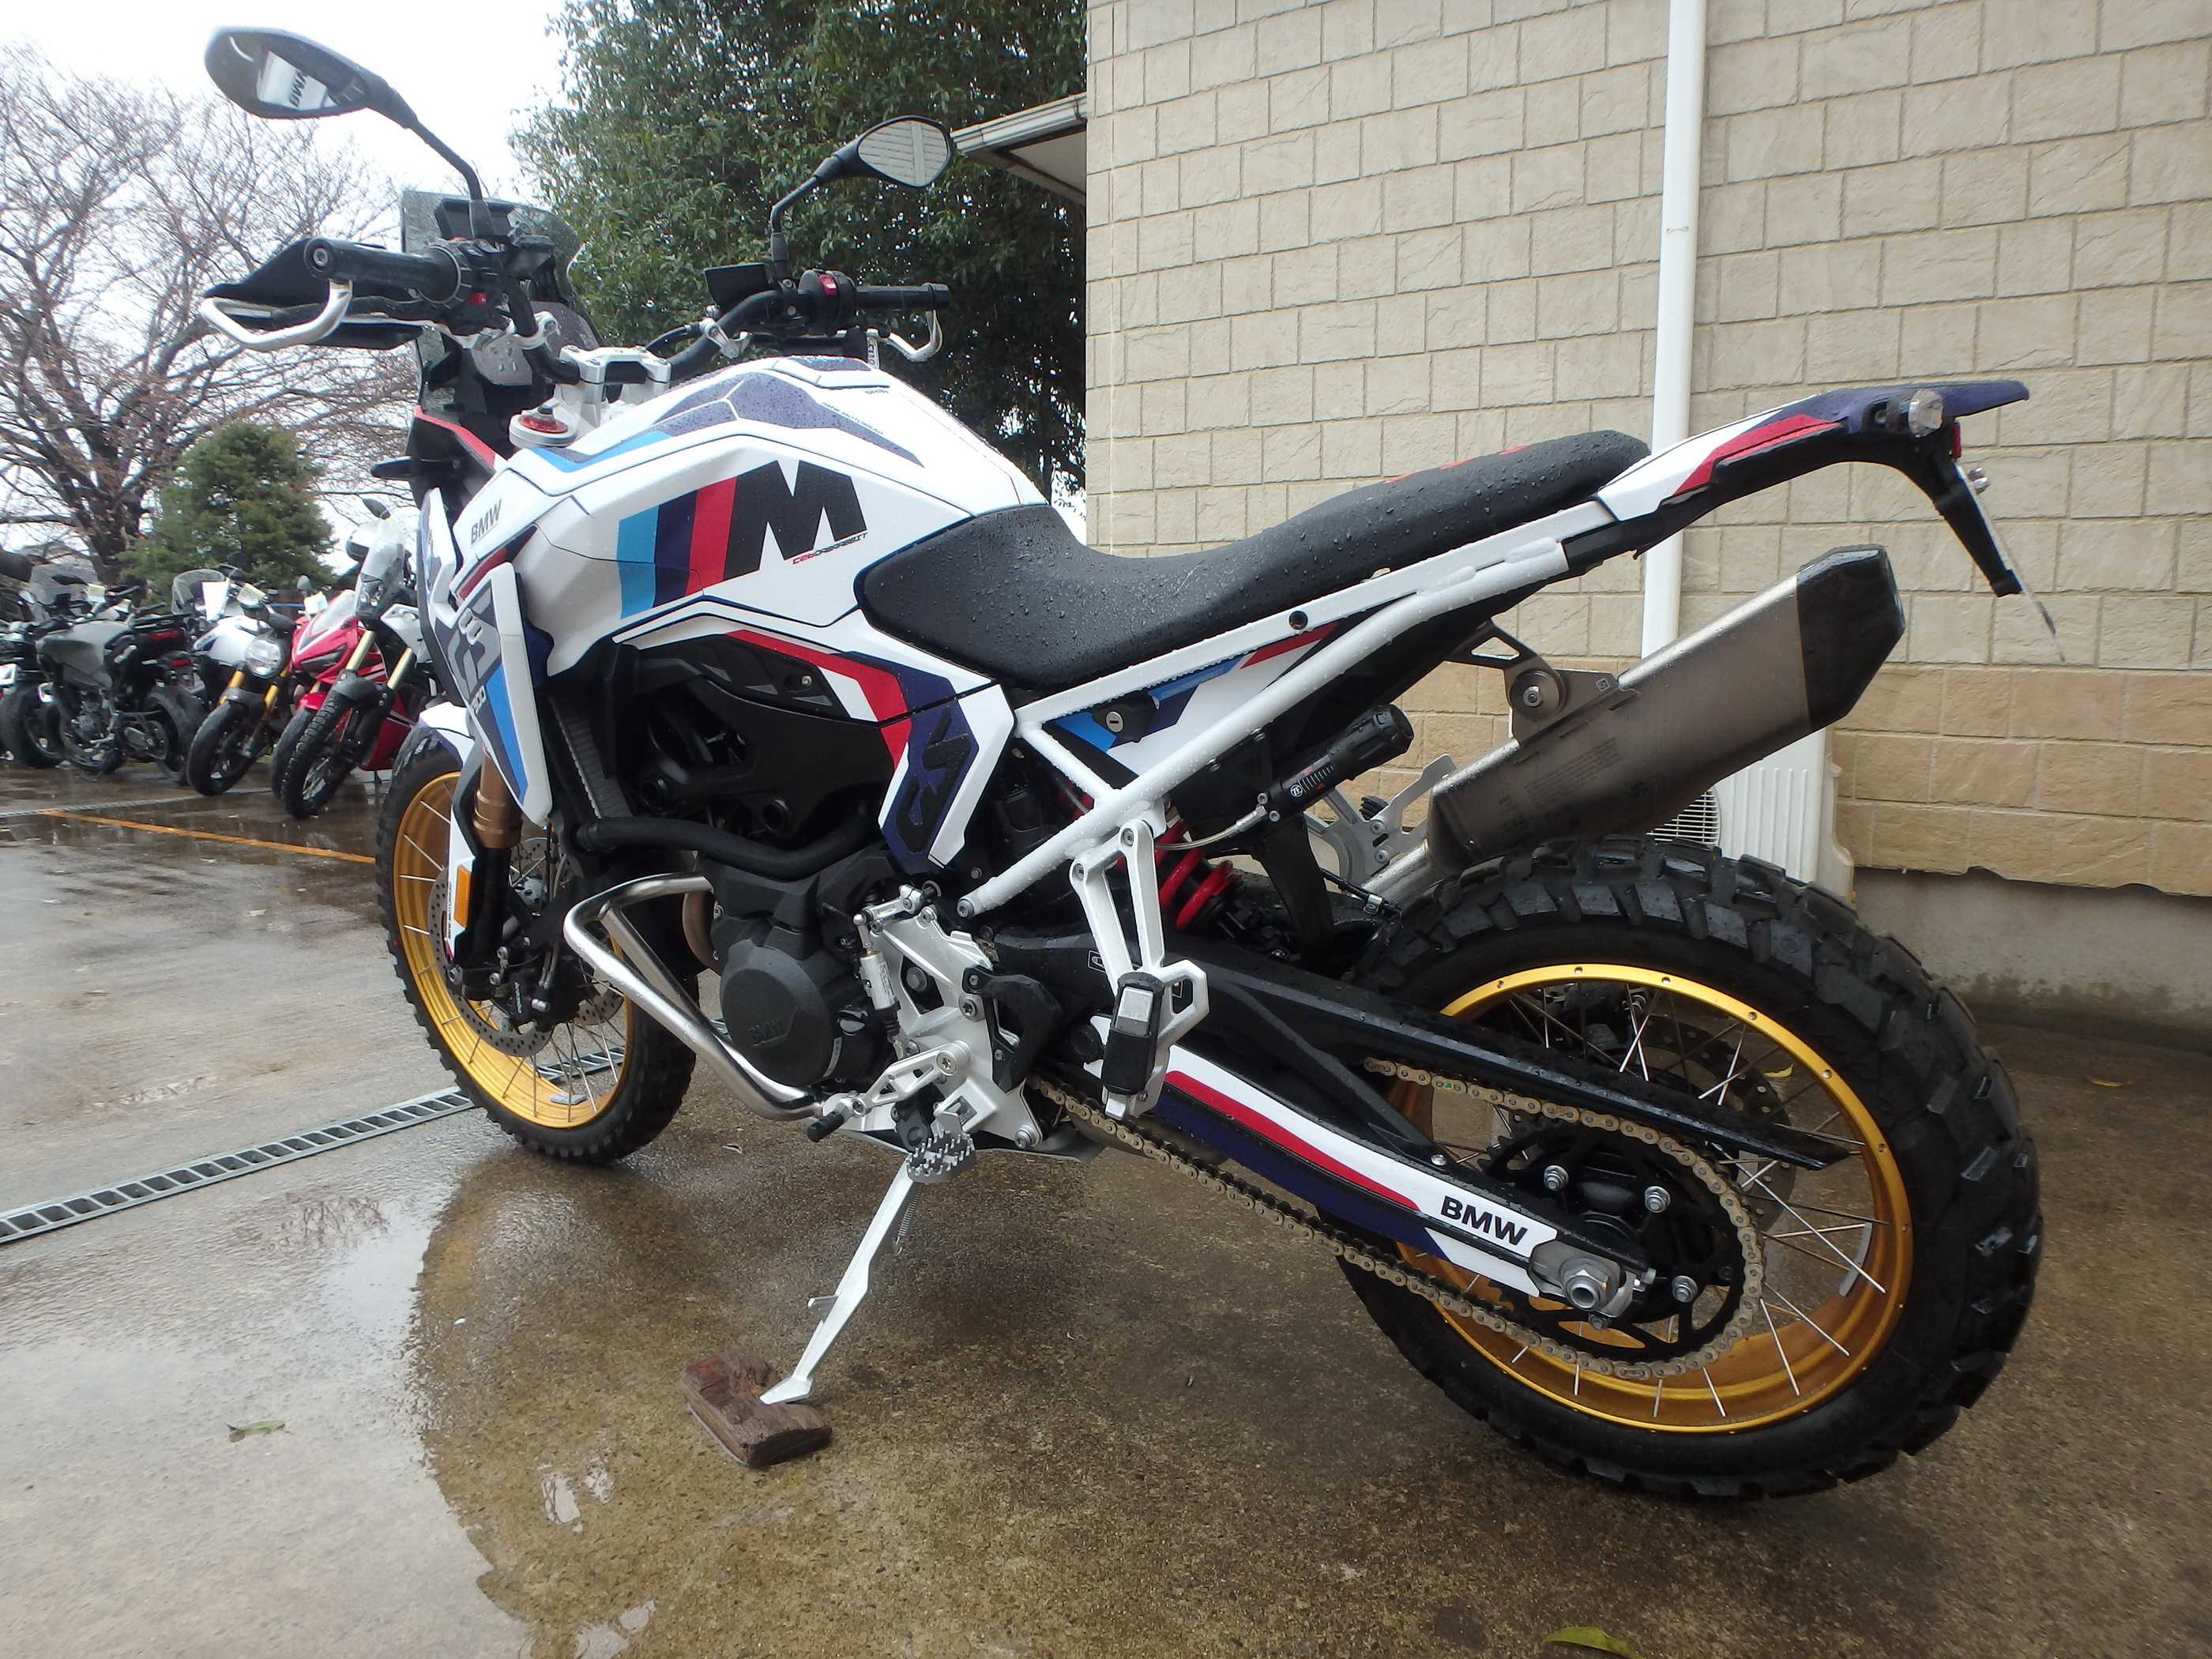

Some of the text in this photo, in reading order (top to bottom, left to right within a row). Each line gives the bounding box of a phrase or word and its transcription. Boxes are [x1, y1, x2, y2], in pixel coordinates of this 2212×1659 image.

[471, 498, 502, 546] BMW
[722, 460, 868, 582] M
[895, 707, 973, 854] GS
[1439, 1194, 1529, 1247] BMW
